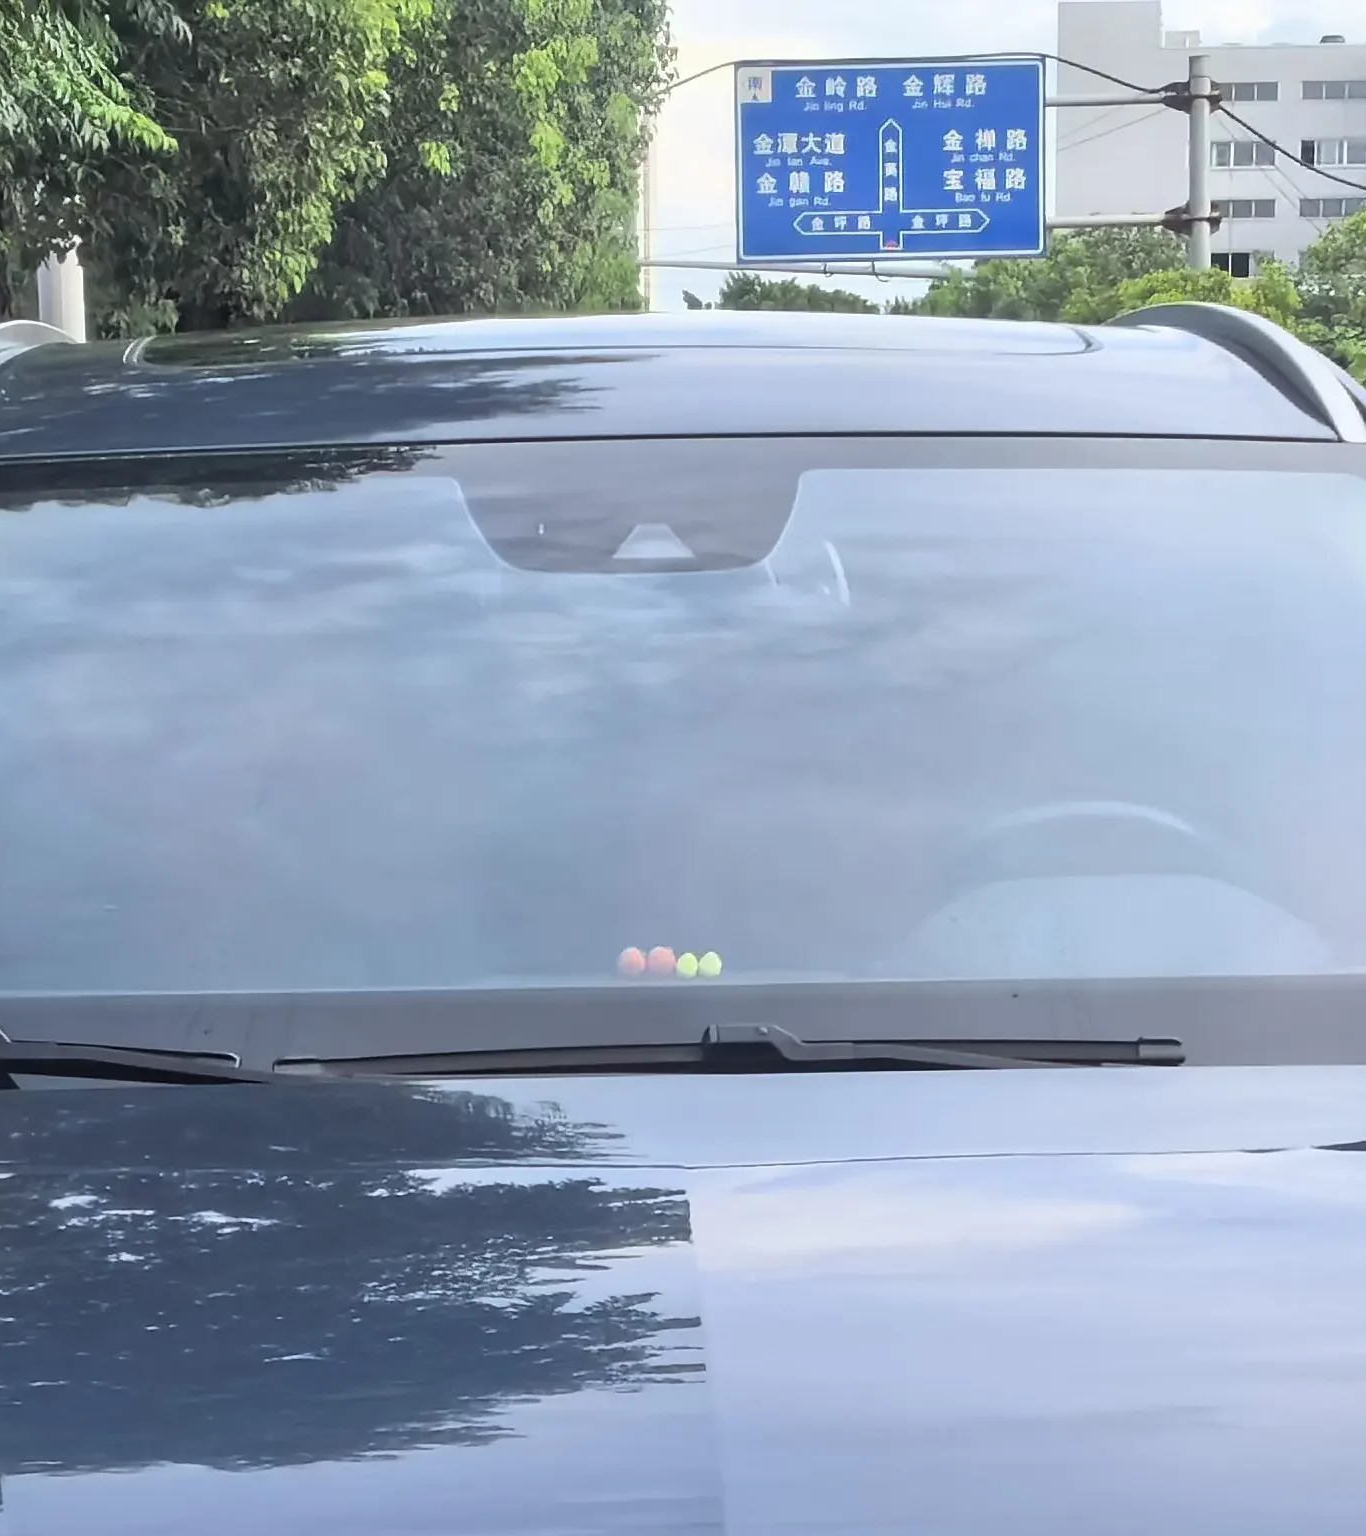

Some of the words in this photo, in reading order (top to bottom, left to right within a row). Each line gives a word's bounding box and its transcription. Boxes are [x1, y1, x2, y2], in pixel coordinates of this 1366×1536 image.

[795, 75, 878, 98] 金岭路
[902, 73, 987, 97] 金辉路
[942, 167, 1027, 191] 宝福路
